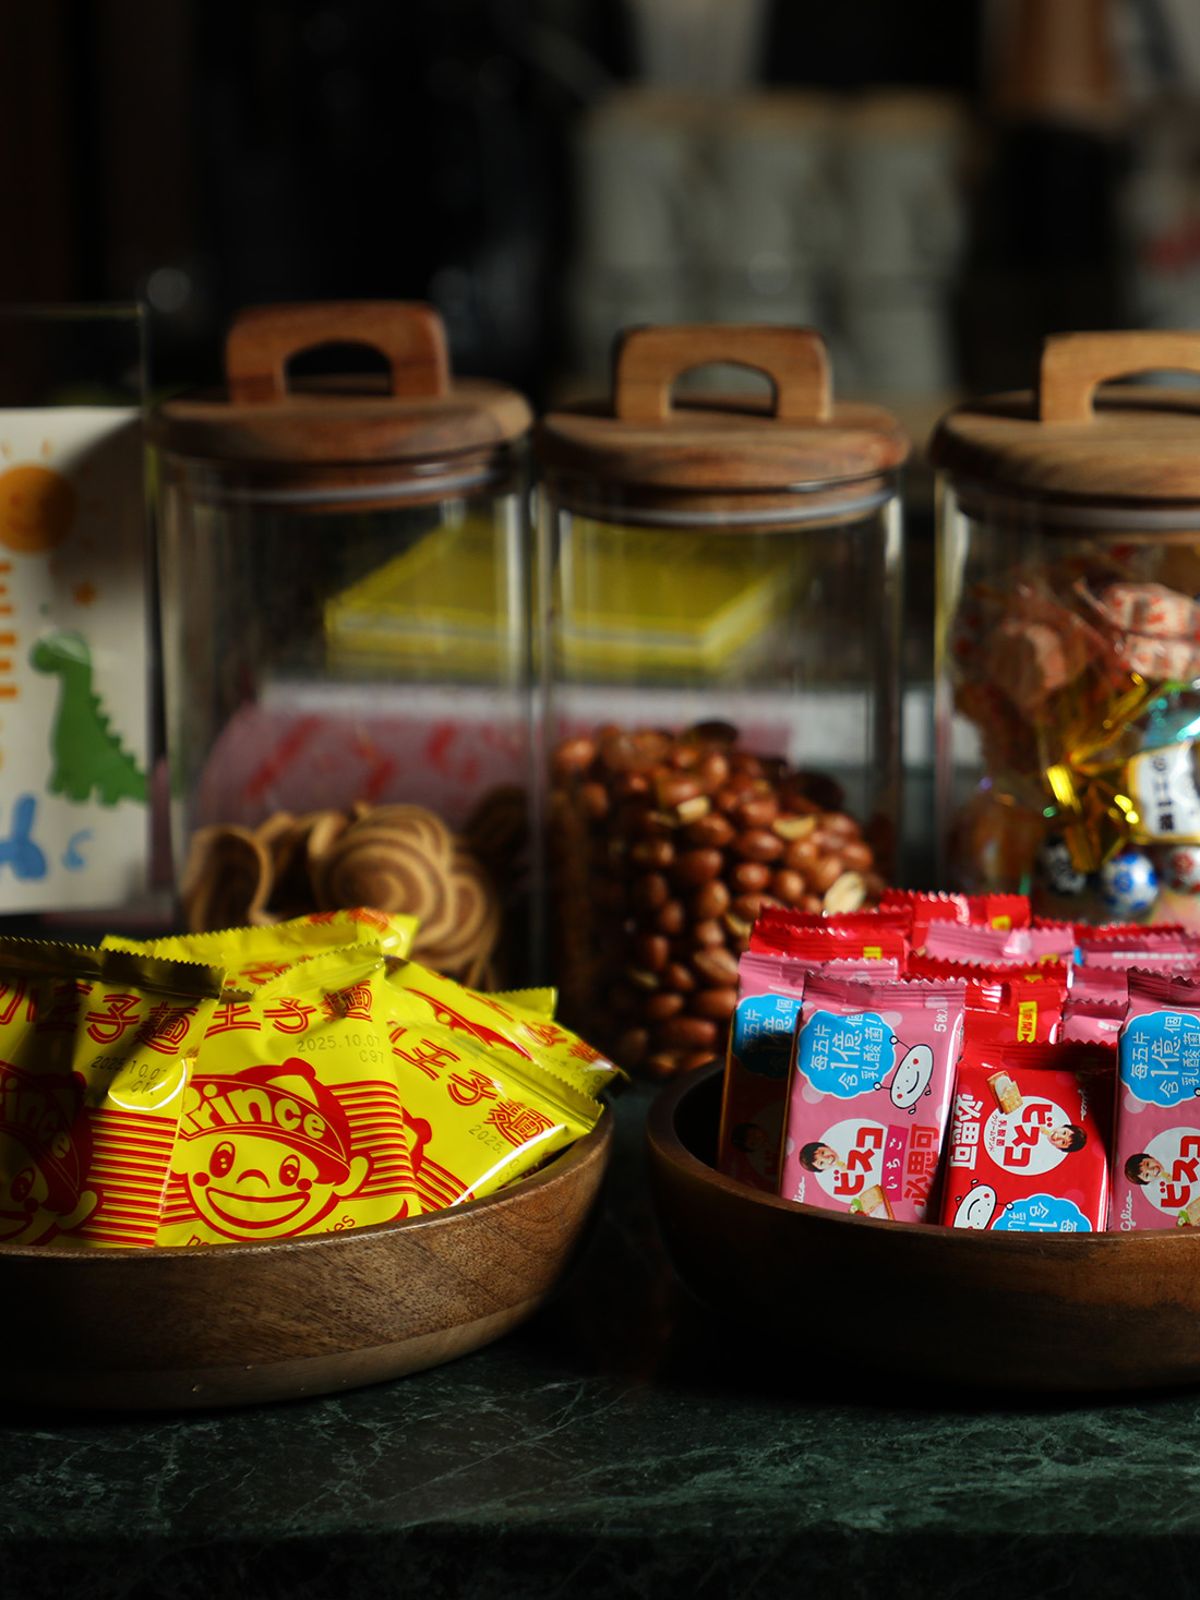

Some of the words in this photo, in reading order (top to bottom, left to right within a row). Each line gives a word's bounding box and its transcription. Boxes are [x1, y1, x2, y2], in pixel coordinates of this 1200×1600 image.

[811, 1024, 831, 1072] 每五片
[1130, 1030, 1151, 1081] 每五片
[179, 1084, 327, 1140] Prince
[949, 1093, 984, 1171] 必思可
[1002, 1102, 1054, 1169] ビスコ
[833, 1126, 885, 1198] ビスコ
[885, 1137, 903, 1191] いちご
[904, 1122, 941, 1207] 必思可
